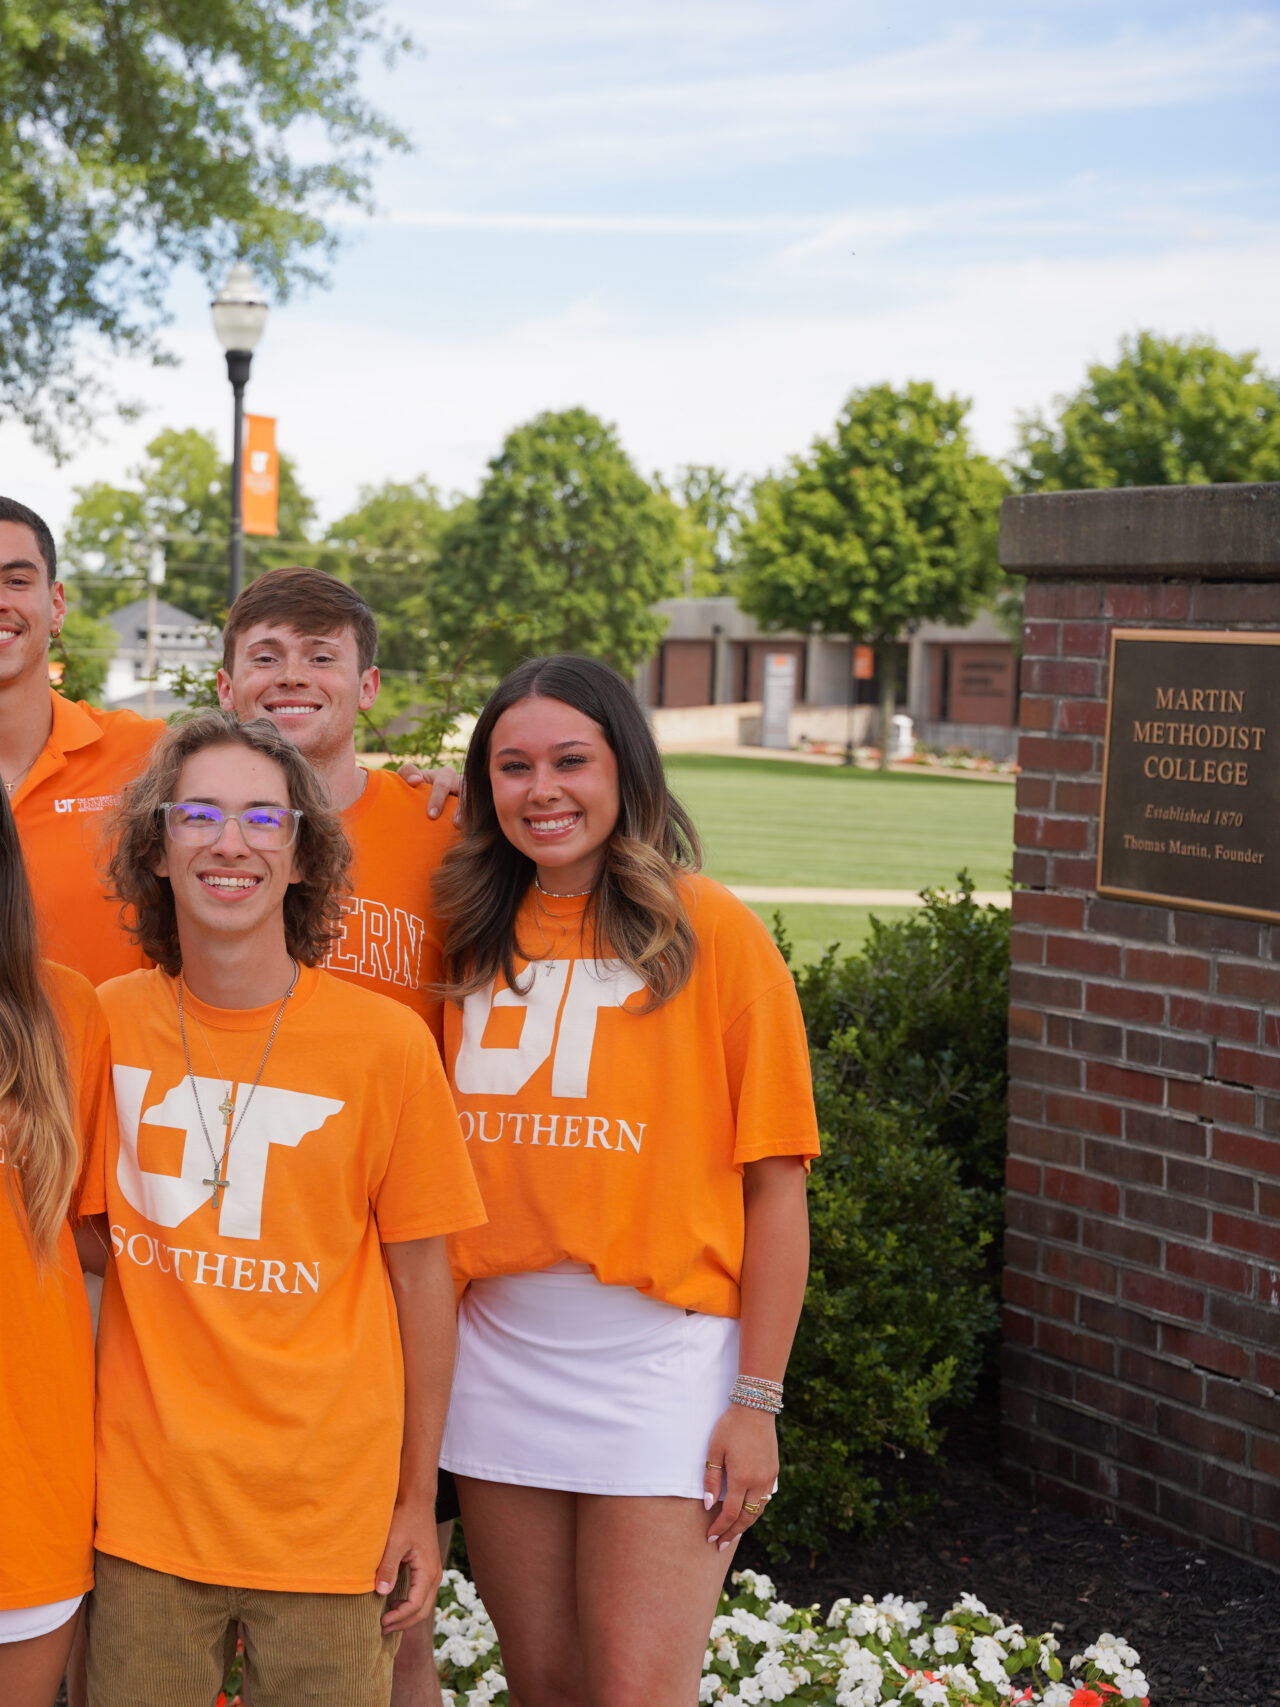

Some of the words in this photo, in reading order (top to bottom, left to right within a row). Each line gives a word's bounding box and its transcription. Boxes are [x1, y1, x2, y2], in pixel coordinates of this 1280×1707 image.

[1155, 687, 1245, 713] MARTIN
[1132, 721, 1266, 751] METHODIST
[1144, 755, 1249, 786] COLLEGE
[1144, 803, 1211, 825] Established
[1214, 810, 1244, 827] 1870
[1123, 834, 1166, 853] Thomas
[1215, 844, 1265, 864] Founder
[317, 894, 424, 990] ERN
[110, 1223, 321, 1294] SOUTHERN
